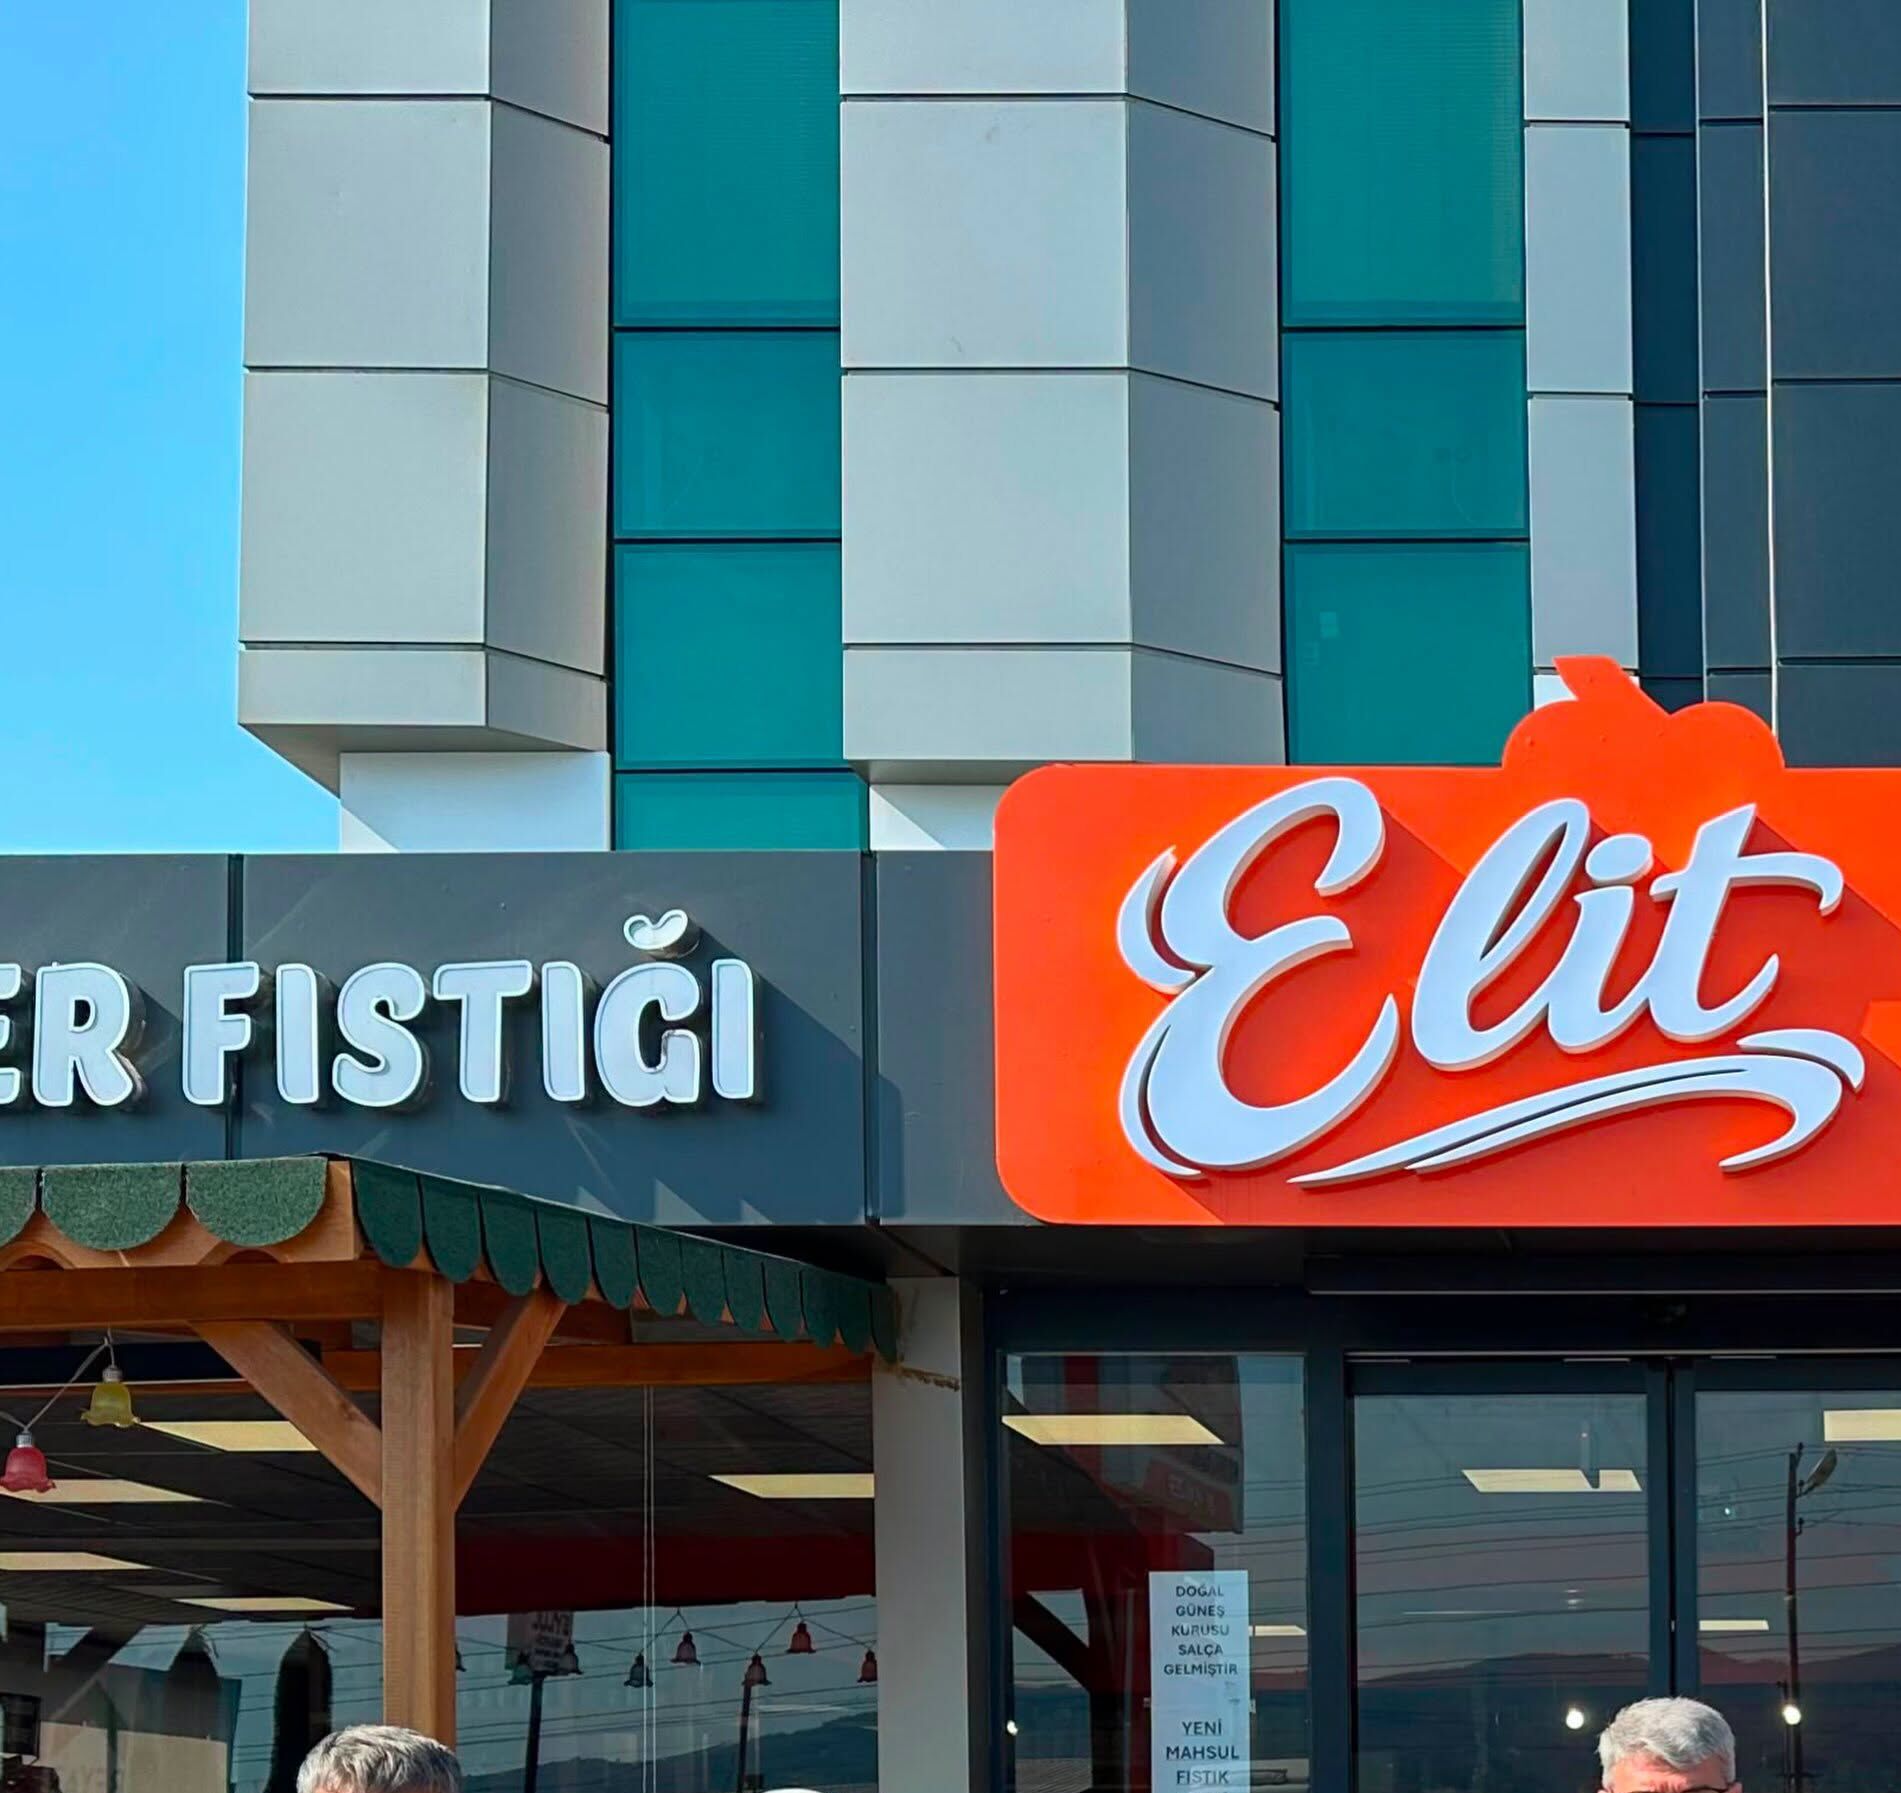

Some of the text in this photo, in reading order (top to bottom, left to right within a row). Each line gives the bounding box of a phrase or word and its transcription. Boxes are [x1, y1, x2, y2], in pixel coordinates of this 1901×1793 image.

[1117, 777, 1845, 1180] Elit
[0, 909, 755, 1107] R FISTIĞI
[1175, 1583, 1225, 1598] DOĞAL
[1175, 1603, 1225, 1618] GÜNEŞ
[1171, 1624, 1230, 1637] KURUSU
[1177, 1644, 1224, 1659] SALÇA
[1163, 1661, 1239, 1678] GELMİŞTİR
[1181, 1718, 1223, 1736] YENİ
[1165, 1745, 1240, 1760] MAHSUL
[1175, 1770, 1230, 1785] FISTIK
